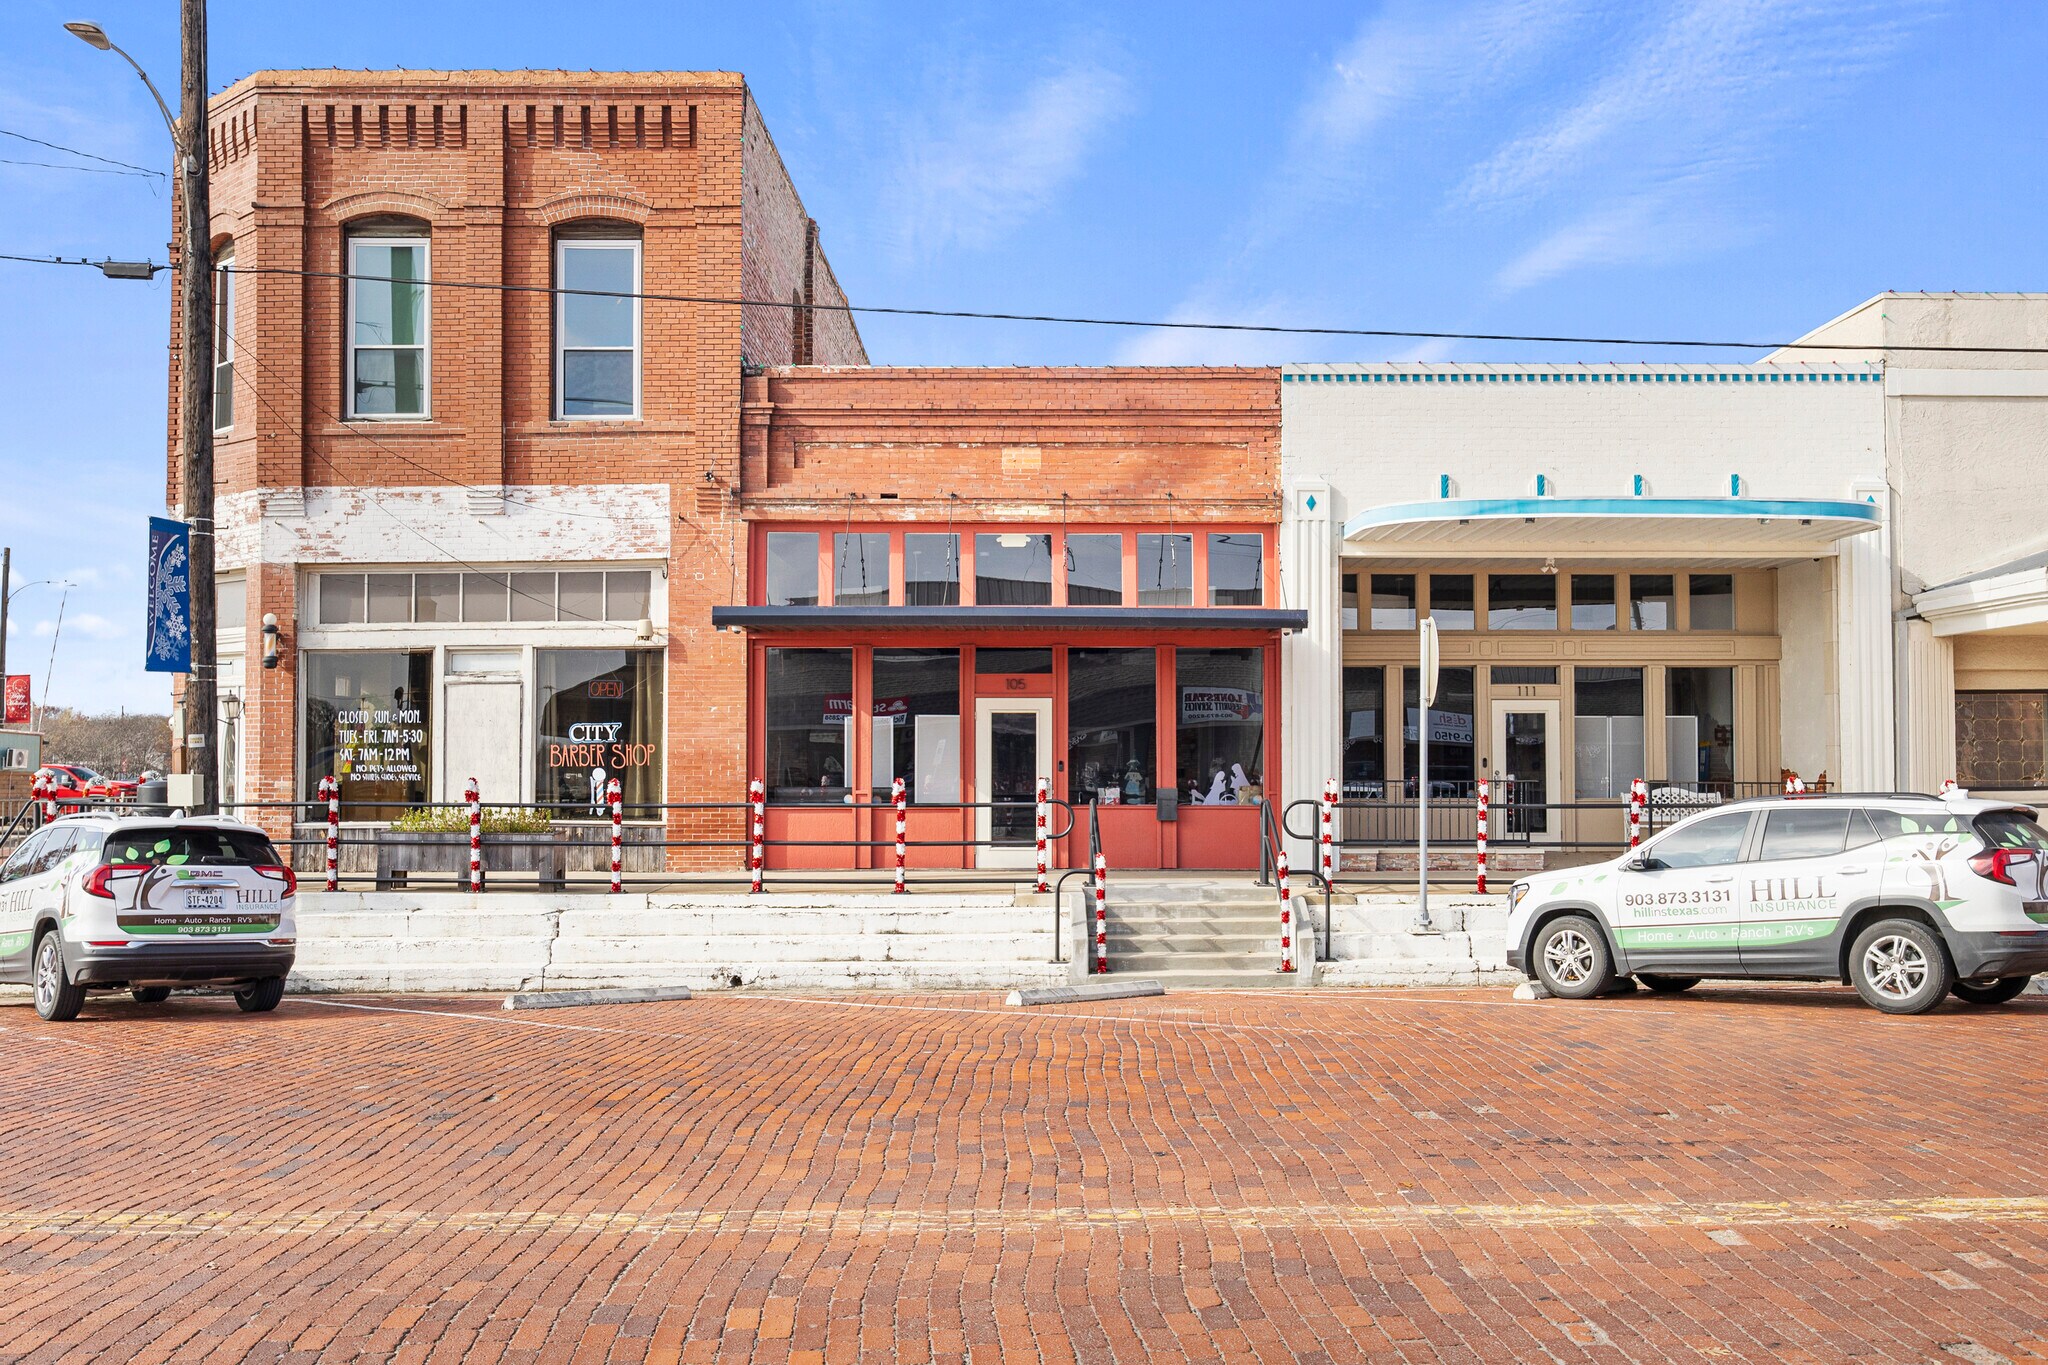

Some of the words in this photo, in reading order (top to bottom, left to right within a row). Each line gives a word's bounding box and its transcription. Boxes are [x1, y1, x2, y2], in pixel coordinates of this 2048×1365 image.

[149, 535, 159, 626] WELCOME
[590, 682, 622, 697] OPEN
[1006, 678, 1025, 690] 105
[1518, 686, 1536, 696] 111
[338, 710, 369, 724] CLOSED
[374, 711, 391, 724] SUN.
[392, 714, 398, 722] &
[399, 710, 422, 724] MON.
[570, 724, 620, 742] CITY
[340, 748, 356, 760] SAT.
[550, 744, 605, 767] BARBER
[611, 744, 656, 769] SHOP
[356, 764, 367, 772] NO
[370, 764, 384, 773] PETS
[386, 764, 417, 772] ALLOWED
[236, 890, 277, 903] HILL
[1750, 876, 1838, 902] HILL
[10, 888, 34, 912] HILL
[1625, 889, 1730, 906] 903.873.3131
[1633, 906, 1728, 918] hillinstexas.com
[1750, 898, 1838, 913] INSURANCE
[1638, 930, 1674, 942] Home
[1687, 928, 1718, 940] Auto
[1731, 926, 1771, 938] Ranch
[1784, 924, 1814, 937] RV's
